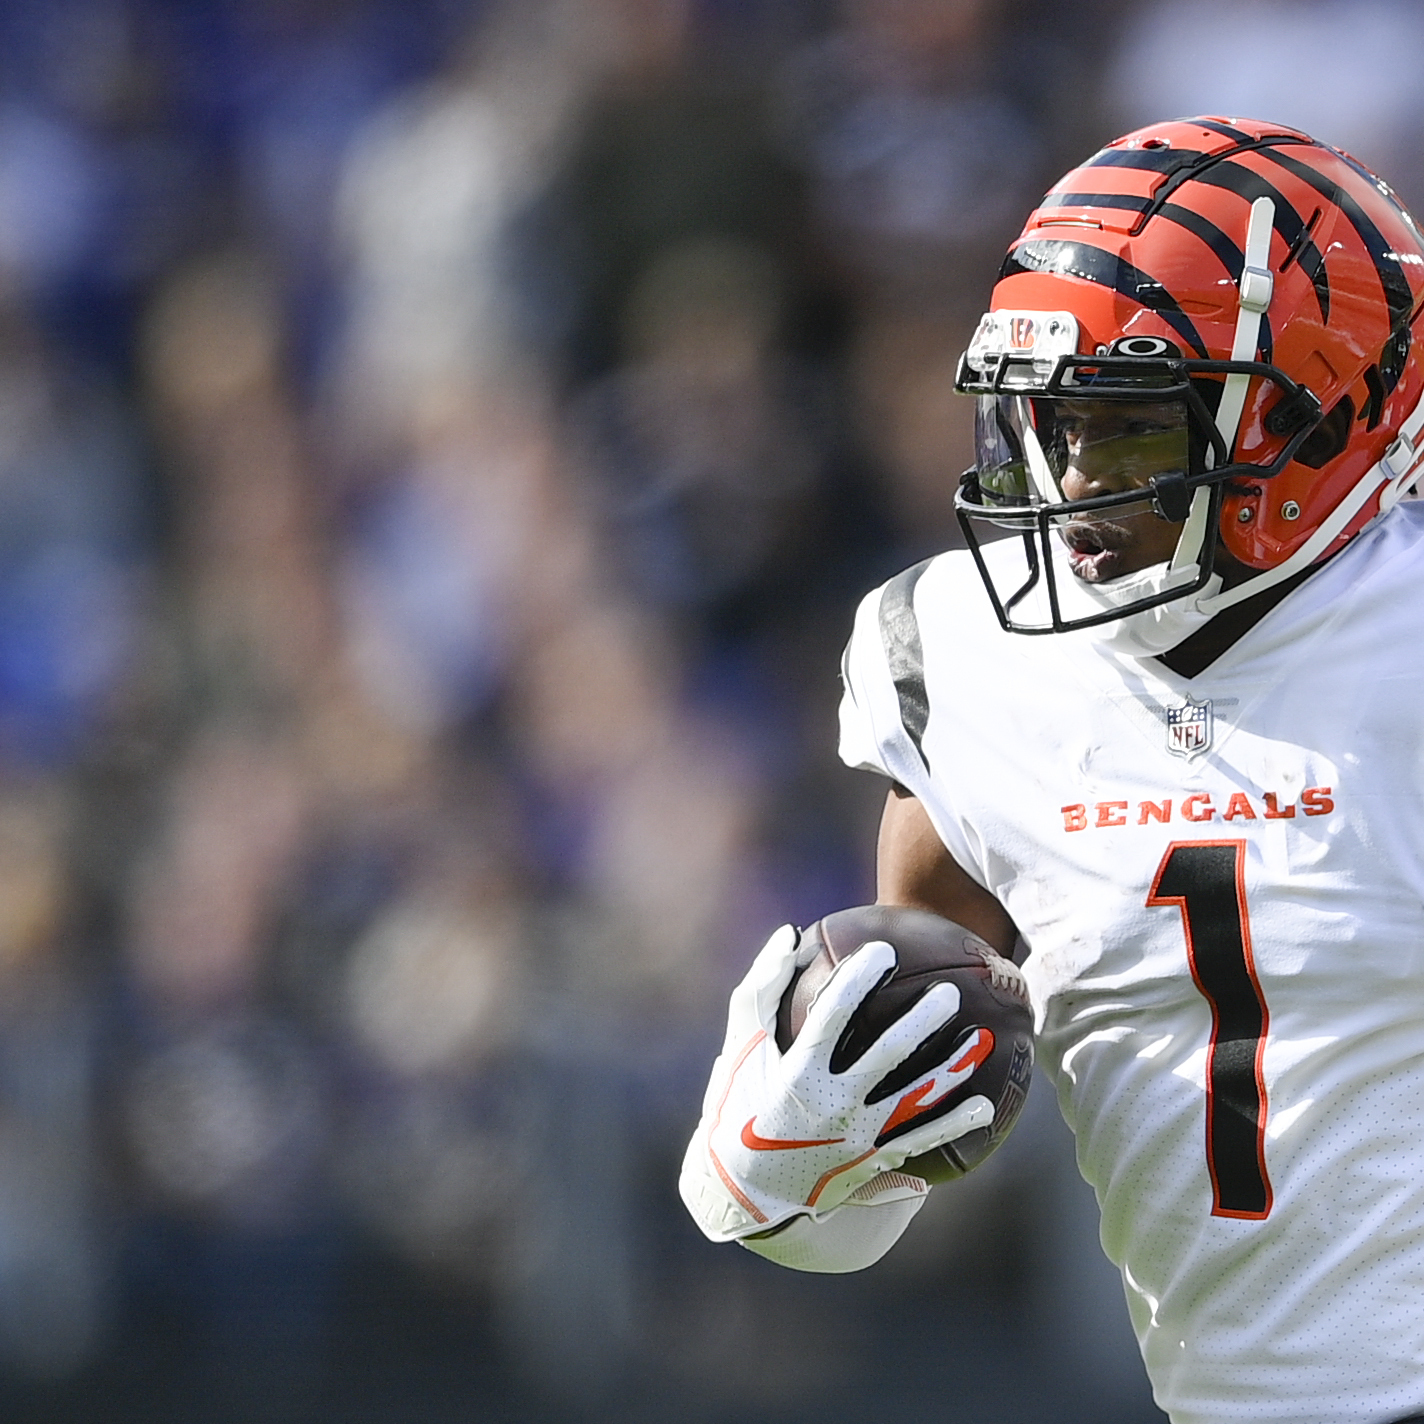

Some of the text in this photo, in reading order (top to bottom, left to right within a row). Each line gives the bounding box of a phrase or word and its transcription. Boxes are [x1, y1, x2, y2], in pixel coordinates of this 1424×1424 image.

[1171, 724, 1204, 750] NFL
[1061, 786, 1336, 833] BENGALS
[1146, 838, 1273, 1221] 1
